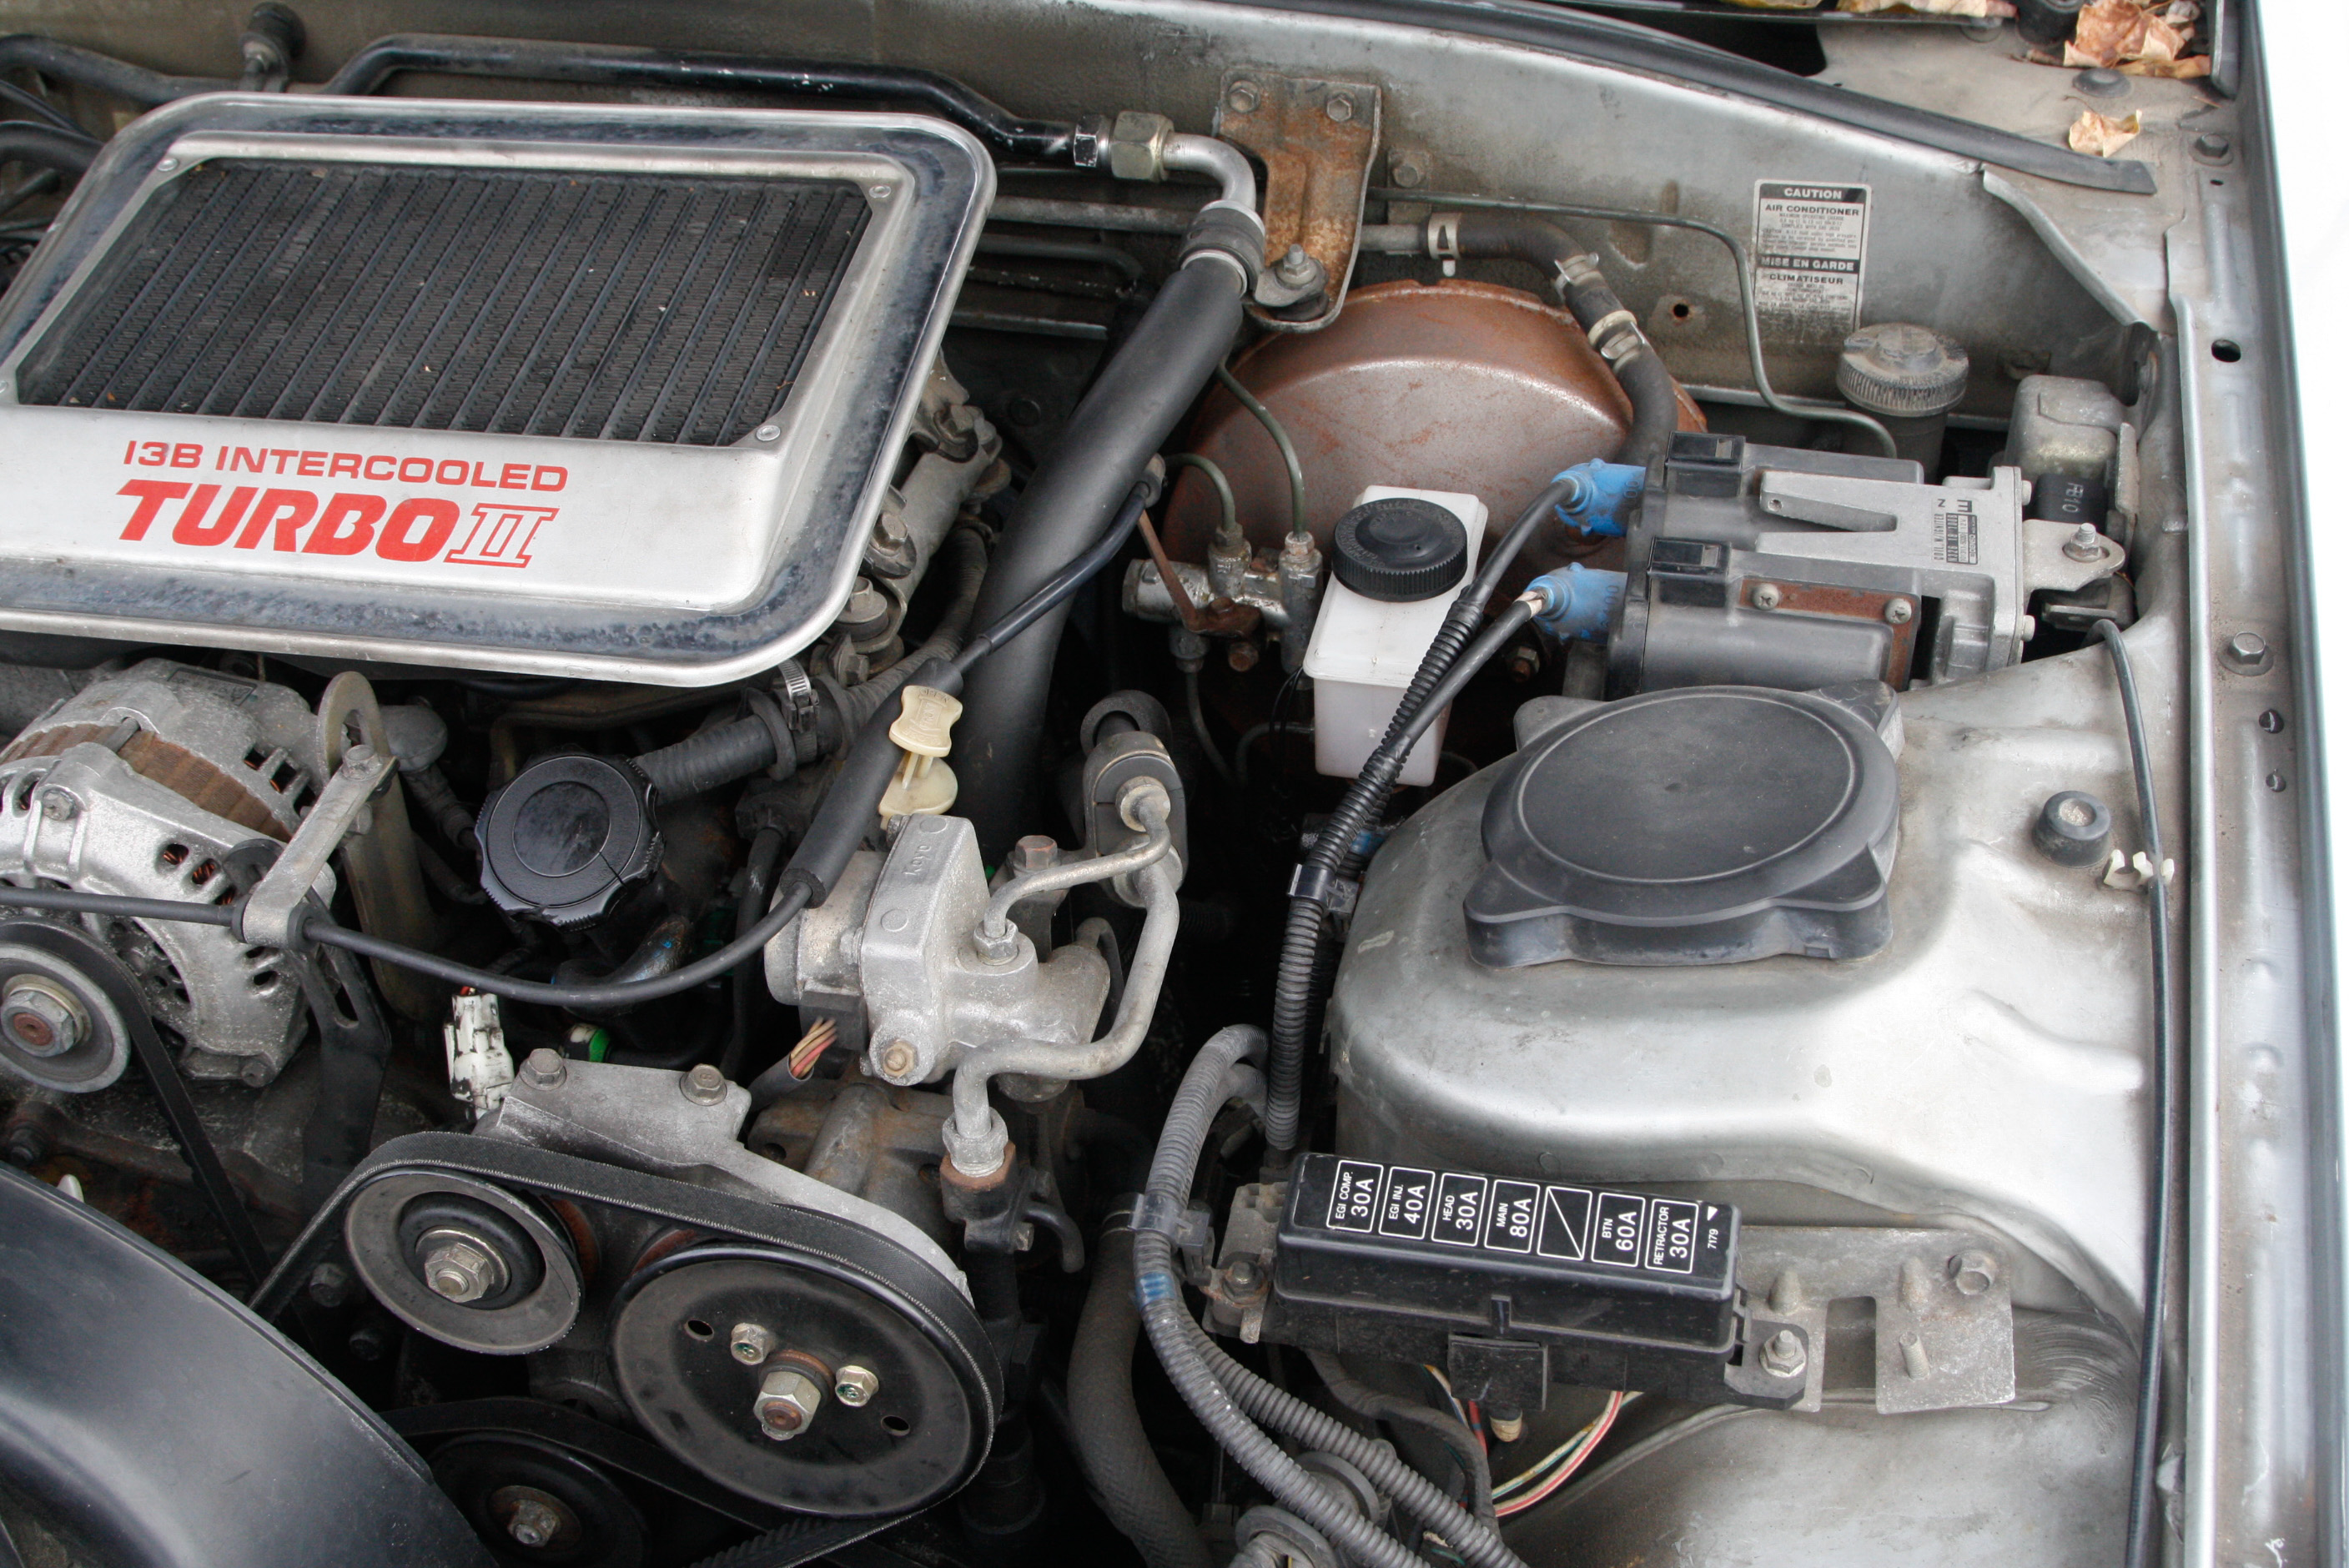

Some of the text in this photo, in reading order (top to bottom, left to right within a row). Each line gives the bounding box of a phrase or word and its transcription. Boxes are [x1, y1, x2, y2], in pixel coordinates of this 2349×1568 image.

[1784, 187, 1842, 199] CAUTION
[1787, 205, 1859, 216] CONDITIONER
[1761, 256, 1854, 271] MISE EN GARDE
[1769, 274, 1843, 284] CLIMATISEUR
[214, 445, 569, 492] INTERCOOLED
[115, 479, 561, 569] TURBO II
[1335, 1171, 1354, 1219] EGI COMP.
[1351, 1179, 1374, 1218] 30A
[1388, 1184, 1404, 1220] EGI INJ.
[1404, 1185, 1426, 1224] 40A
[1442, 1195, 1455, 1221] HEAD
[1456, 1191, 1478, 1231] 30A
[1496, 1202, 1509, 1228] MAIN
[1510, 1199, 1532, 1238] 80A
[1602, 1218, 1613, 1239] BTN
[1615, 1211, 1637, 1251] 60A
[1653, 1206, 1670, 1265] RETRACTOR
[1669, 1219, 1691, 1259] 30A
[1707, 1228, 1719, 1249] 7179
